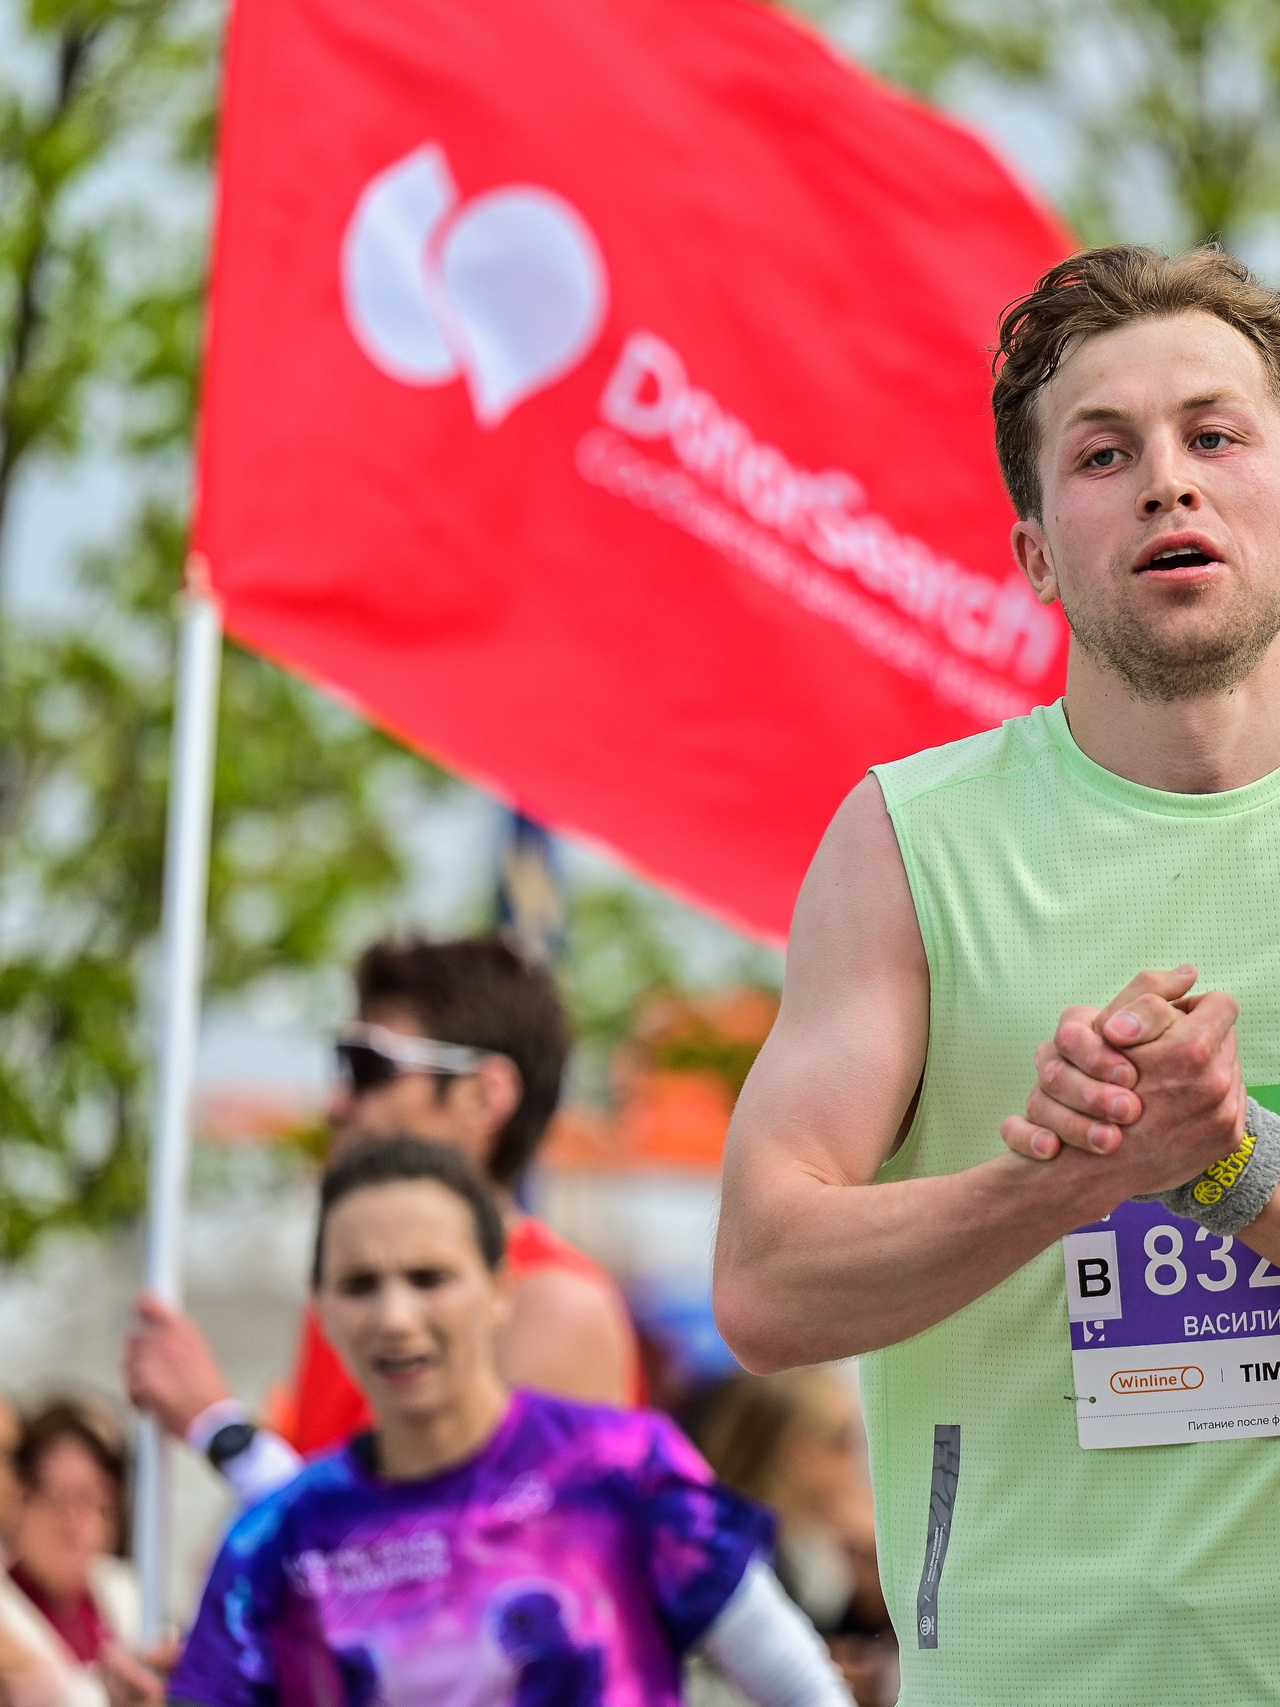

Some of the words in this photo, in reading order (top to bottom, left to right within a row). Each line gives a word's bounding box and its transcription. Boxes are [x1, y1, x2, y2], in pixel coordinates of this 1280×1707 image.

[1219, 1131, 1258, 1188] DUNK
[1077, 1257, 1112, 1298] B
[1118, 1373, 1178, 1389] Winline
[1187, 1420, 1235, 1431] Питание
[1237, 1416, 1269, 1428] после
